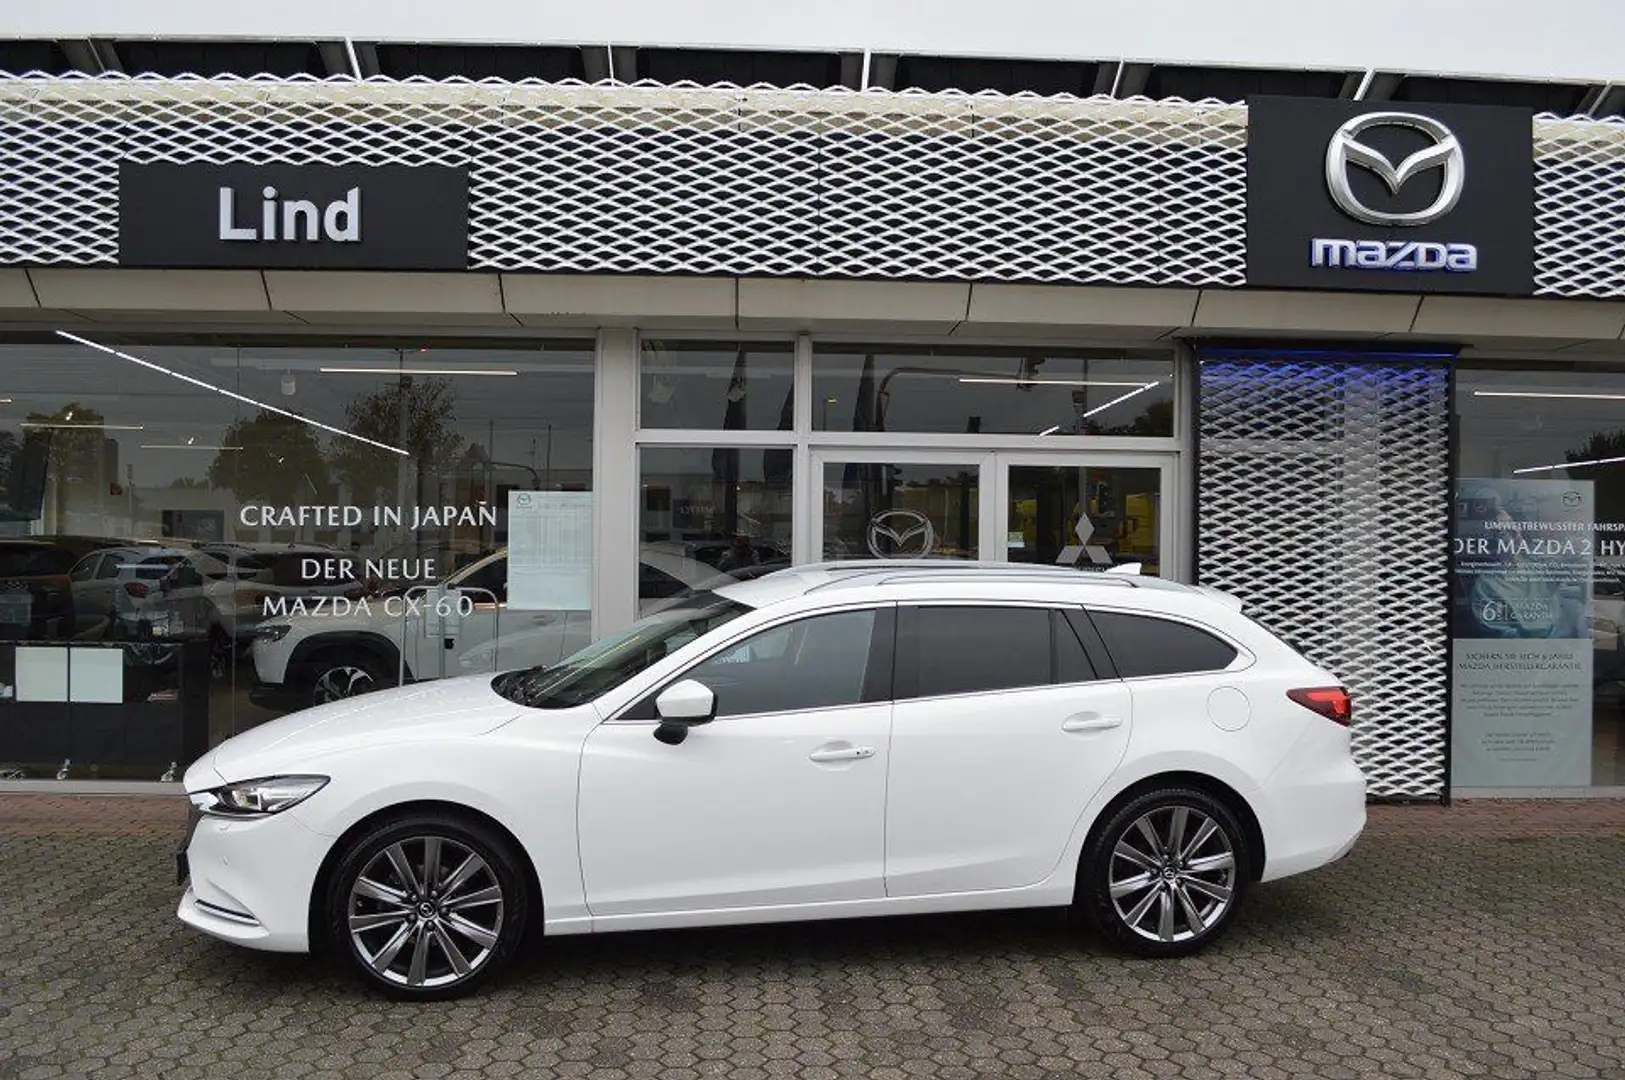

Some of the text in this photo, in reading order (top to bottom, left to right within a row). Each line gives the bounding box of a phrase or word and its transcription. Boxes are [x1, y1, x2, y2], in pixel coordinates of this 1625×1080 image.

[219, 186, 361, 241] Lind
[240, 505, 498, 530] CRAFTED IN JAPAN
[1484, 521, 1625, 533] UMWELTBEWUSSTER FAHRSP
[1497, 538, 1575, 555] MAZDA
[1580, 539, 1592, 555] 2
[301, 558, 436, 579] DER NEUE
[263, 596, 473, 617] MAZDA CX-60
